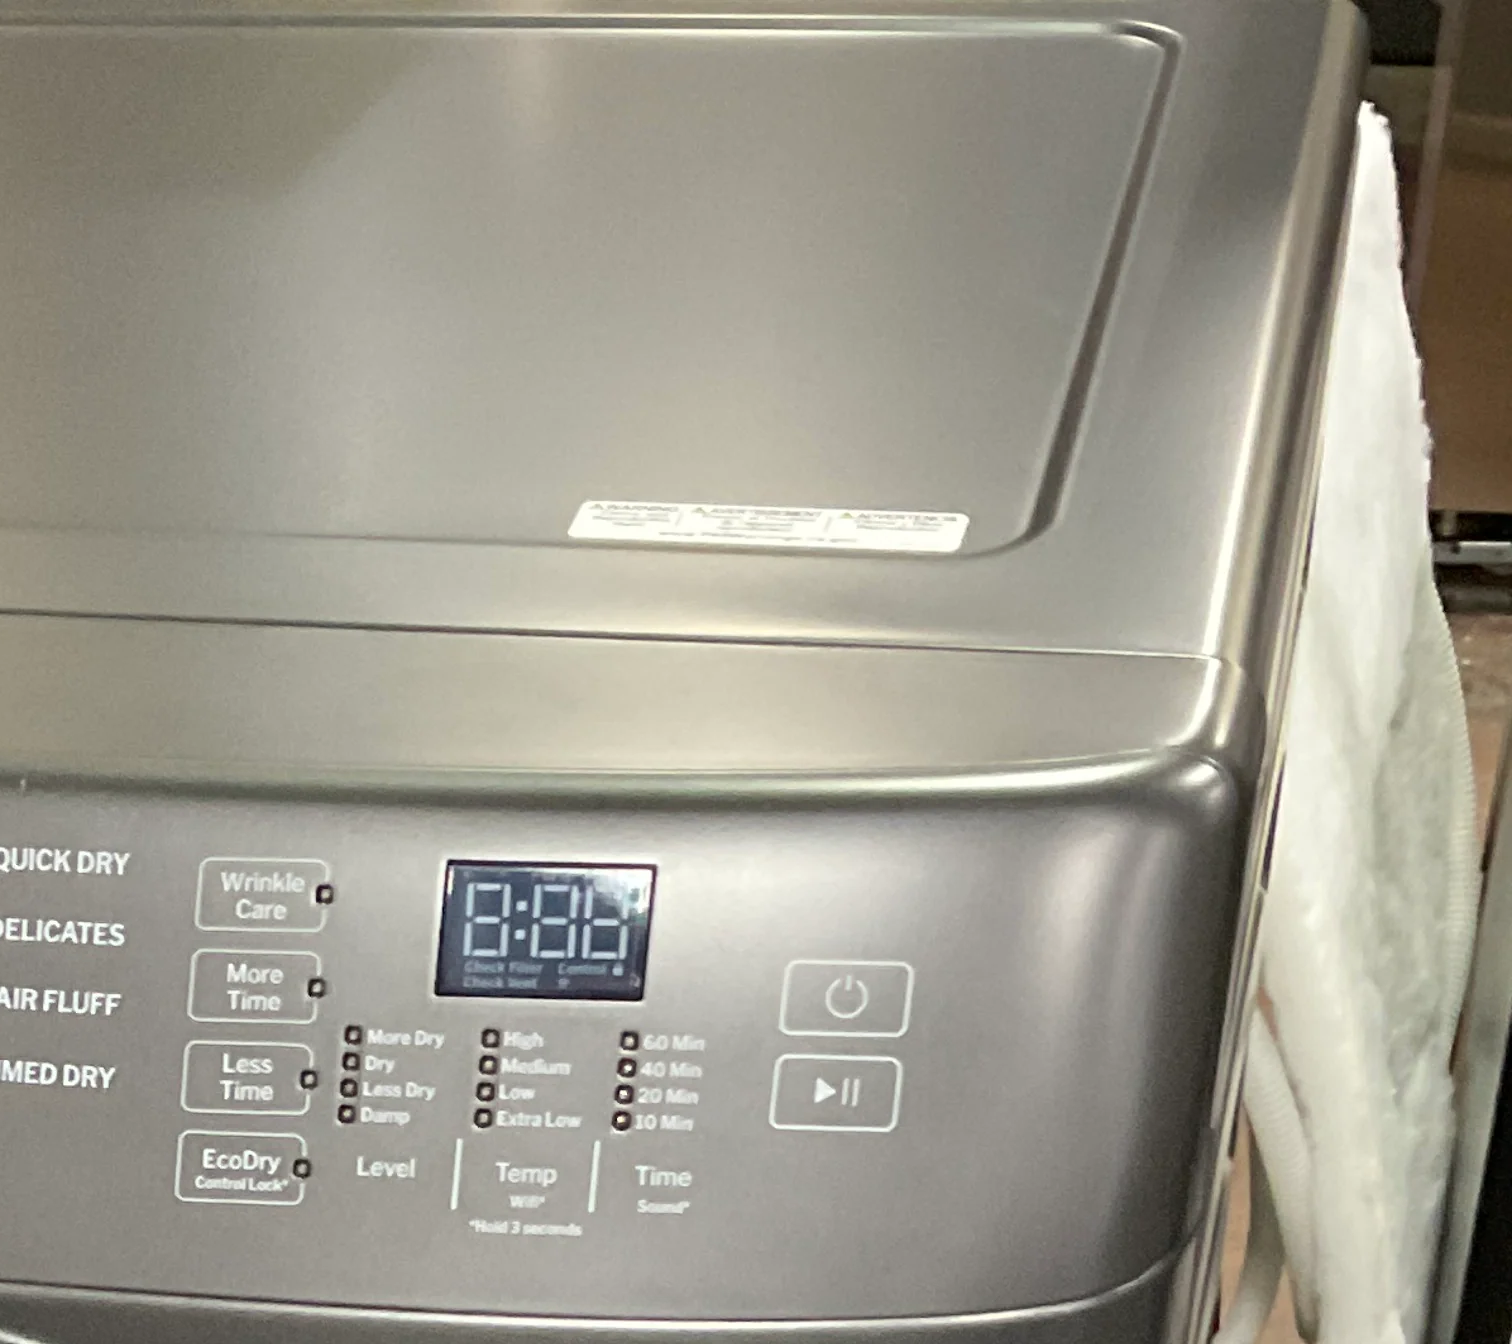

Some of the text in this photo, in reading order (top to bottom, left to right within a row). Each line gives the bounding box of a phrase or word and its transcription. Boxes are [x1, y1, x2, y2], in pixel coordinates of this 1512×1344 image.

[76, 851, 131, 876] DRY
[220, 871, 306, 893] Wrinkle
[235, 898, 287, 920] Care
[226, 963, 284, 985] More
[42, 990, 122, 1016] FLUFF
[227, 989, 282, 1012] Time
[366, 1028, 445, 1050] More Dry
[503, 1031, 545, 1051] High
[643, 1034, 706, 1052] 60 Min
[222, 1053, 274, 1075] Less
[364, 1055, 396, 1074] Dry
[500, 1057, 573, 1076] Medium
[640, 1061, 703, 1079] 40 Min
[62, 1065, 116, 1089] DRY
[219, 1080, 275, 1102] Time
[362, 1081, 437, 1101] Less Dry
[498, 1084, 536, 1100] Low
[638, 1088, 700, 1106] 20 Min
[360, 1106, 411, 1127] Damp
[496, 1110, 583, 1129] Extra Low
[635, 1114, 694, 1132] 10 Min
[202, 1148, 282, 1175] EcoDry
[356, 1155, 418, 1179] Level
[194, 1175, 247, 1190] Control
[495, 1162, 558, 1187] Temp
[635, 1165, 693, 1188] Time
[511, 1220, 521, 1234] 3
[522, 1222, 583, 1238] seconds
